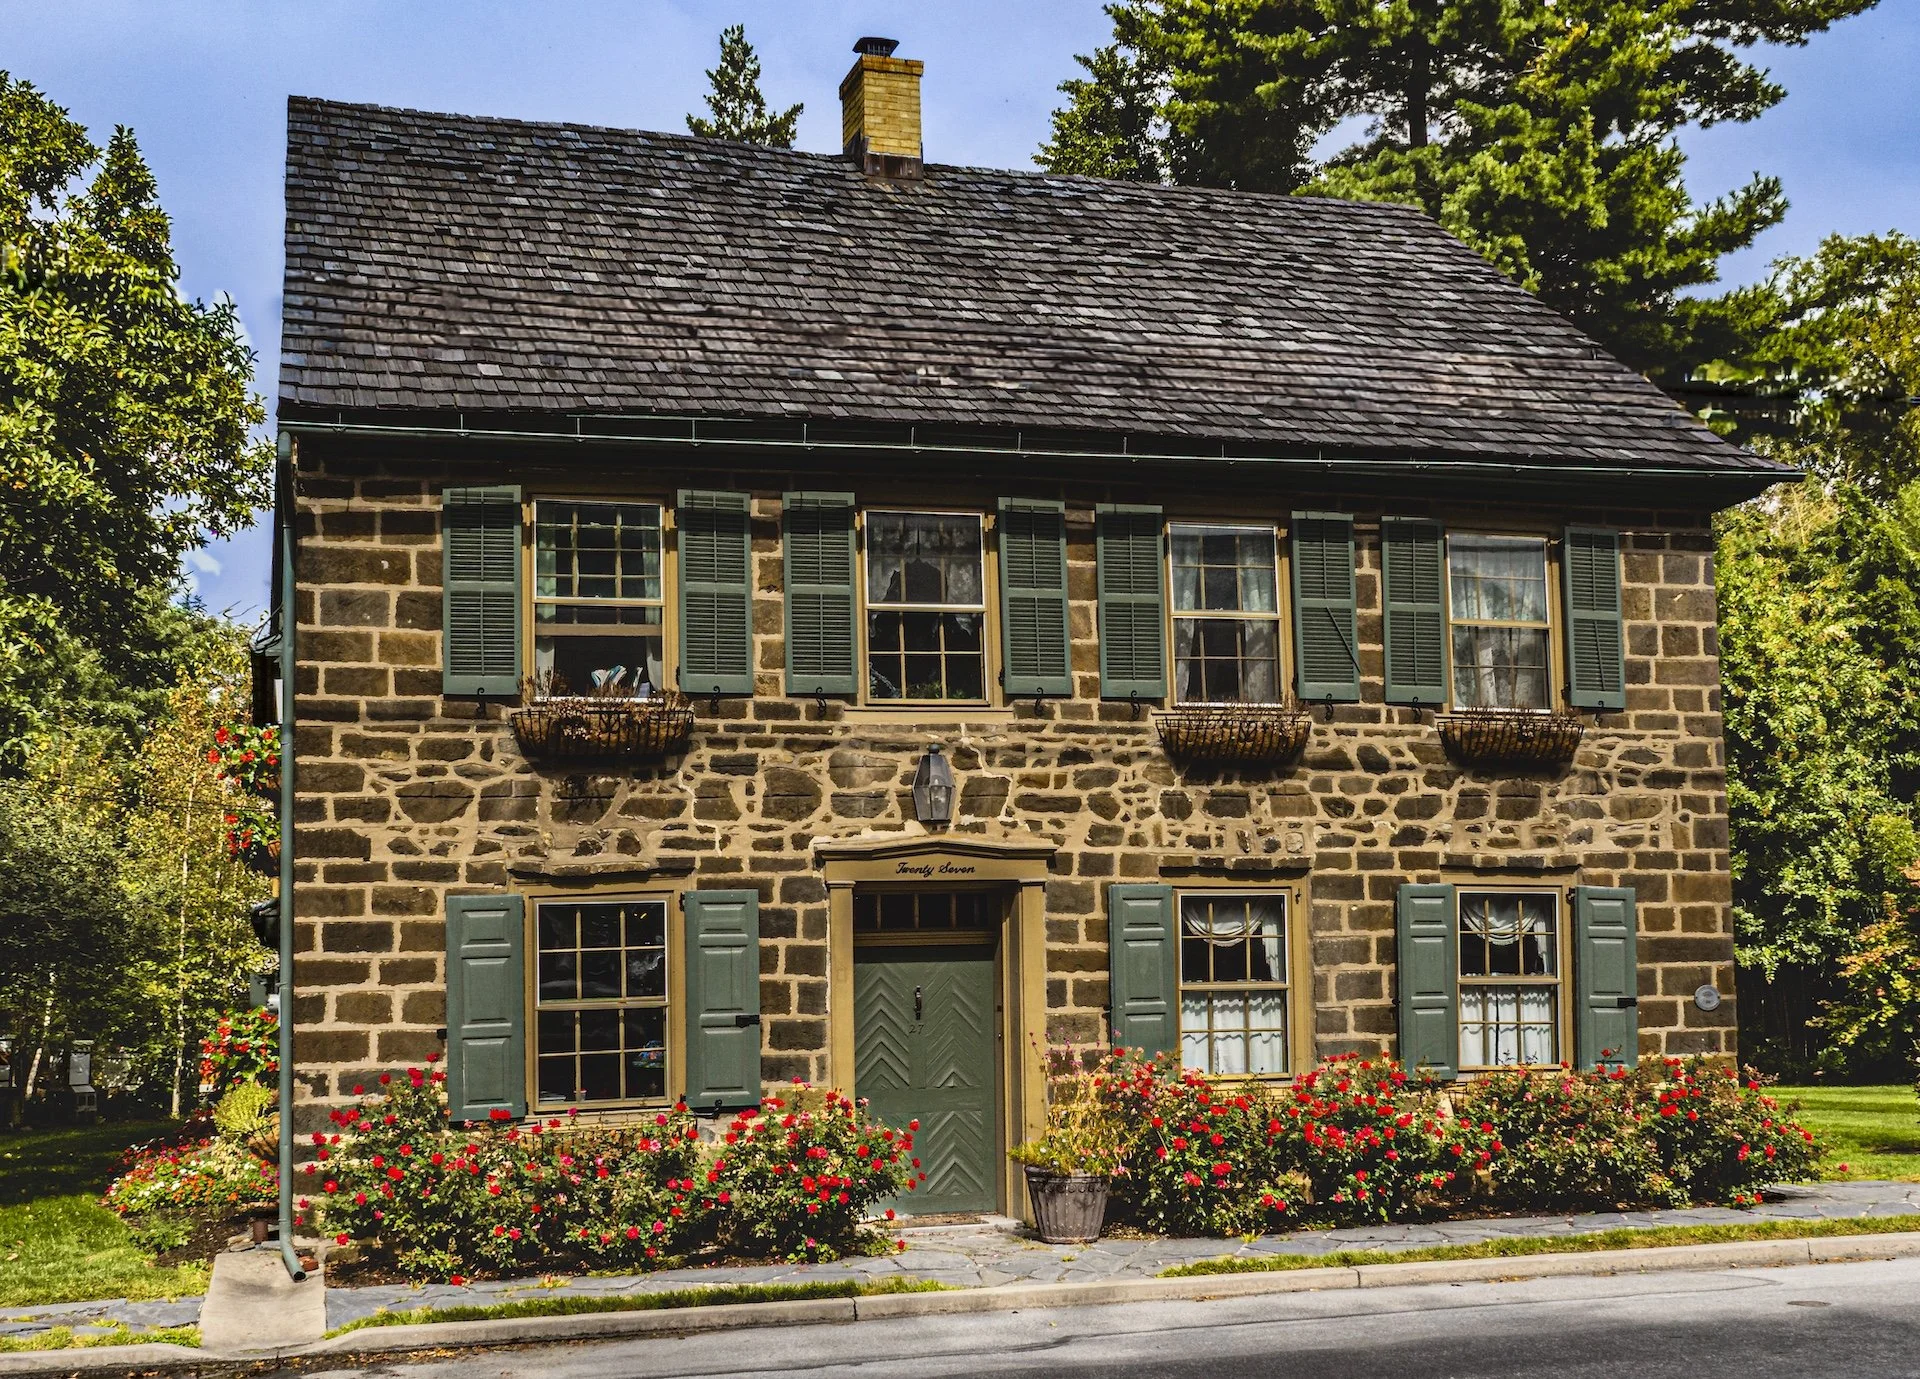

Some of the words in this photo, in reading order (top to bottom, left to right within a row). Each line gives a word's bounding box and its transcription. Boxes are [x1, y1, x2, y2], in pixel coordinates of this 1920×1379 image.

[896, 862, 934, 878] Twenty
[938, 861, 975, 874] Seven
[909, 1024, 924, 1034] 27
